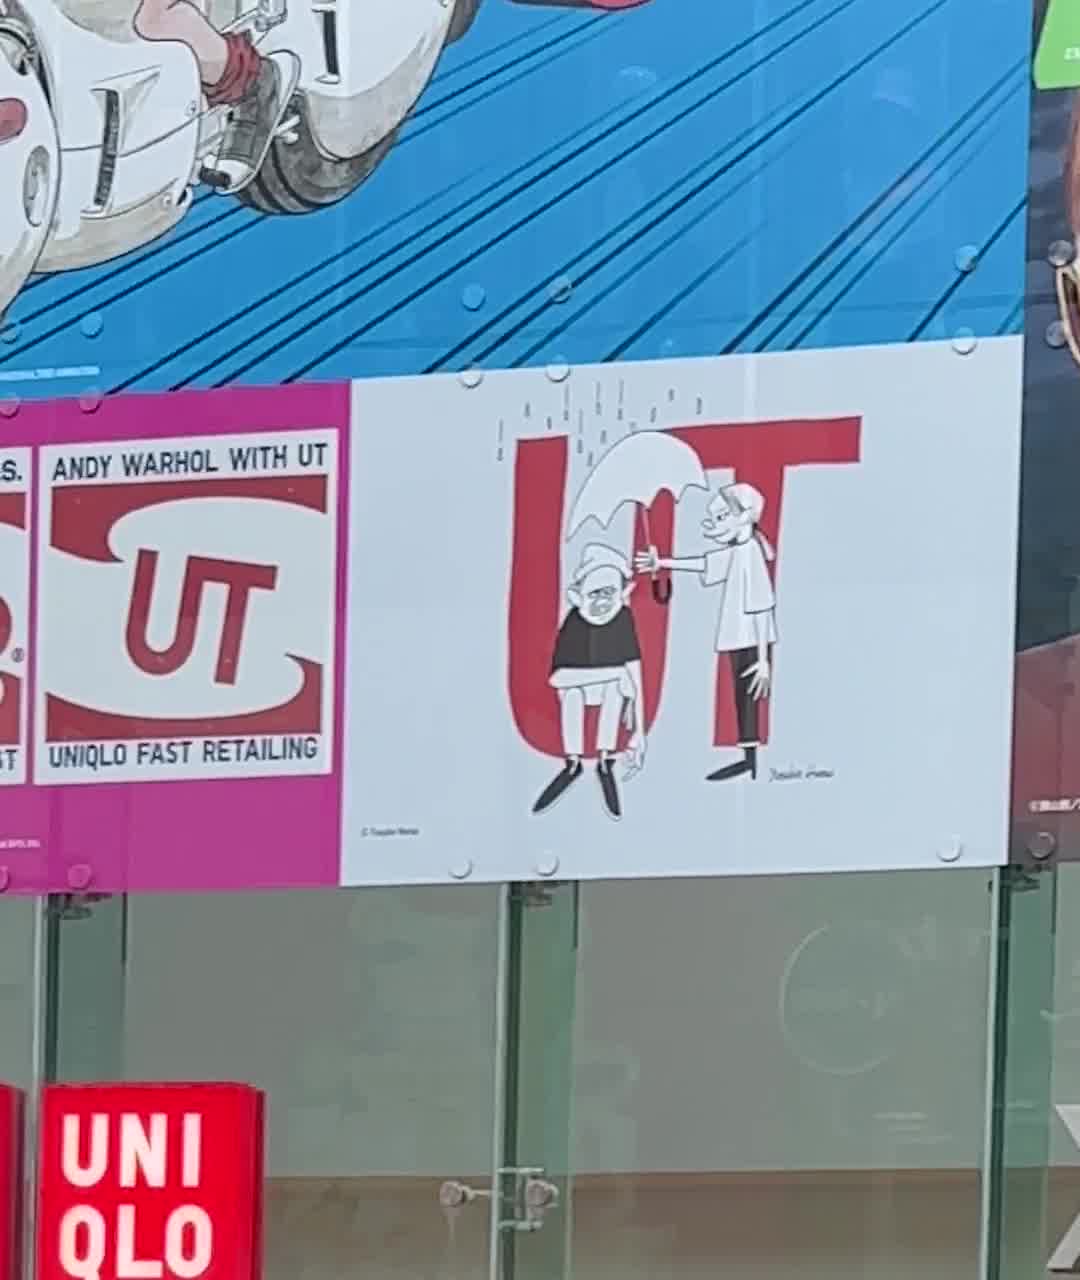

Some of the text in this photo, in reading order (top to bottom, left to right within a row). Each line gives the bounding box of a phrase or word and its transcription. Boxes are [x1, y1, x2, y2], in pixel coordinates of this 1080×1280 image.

[53, 442, 328, 480] ANDY WARHOL WITH UT
[508, 415, 862, 758] UT
[124, 547, 279, 686] UT
[0, 748, 18, 771] T
[49, 736, 318, 771] UNIQLO FAST RETAILING
[61, 1112, 202, 1188] UNI
